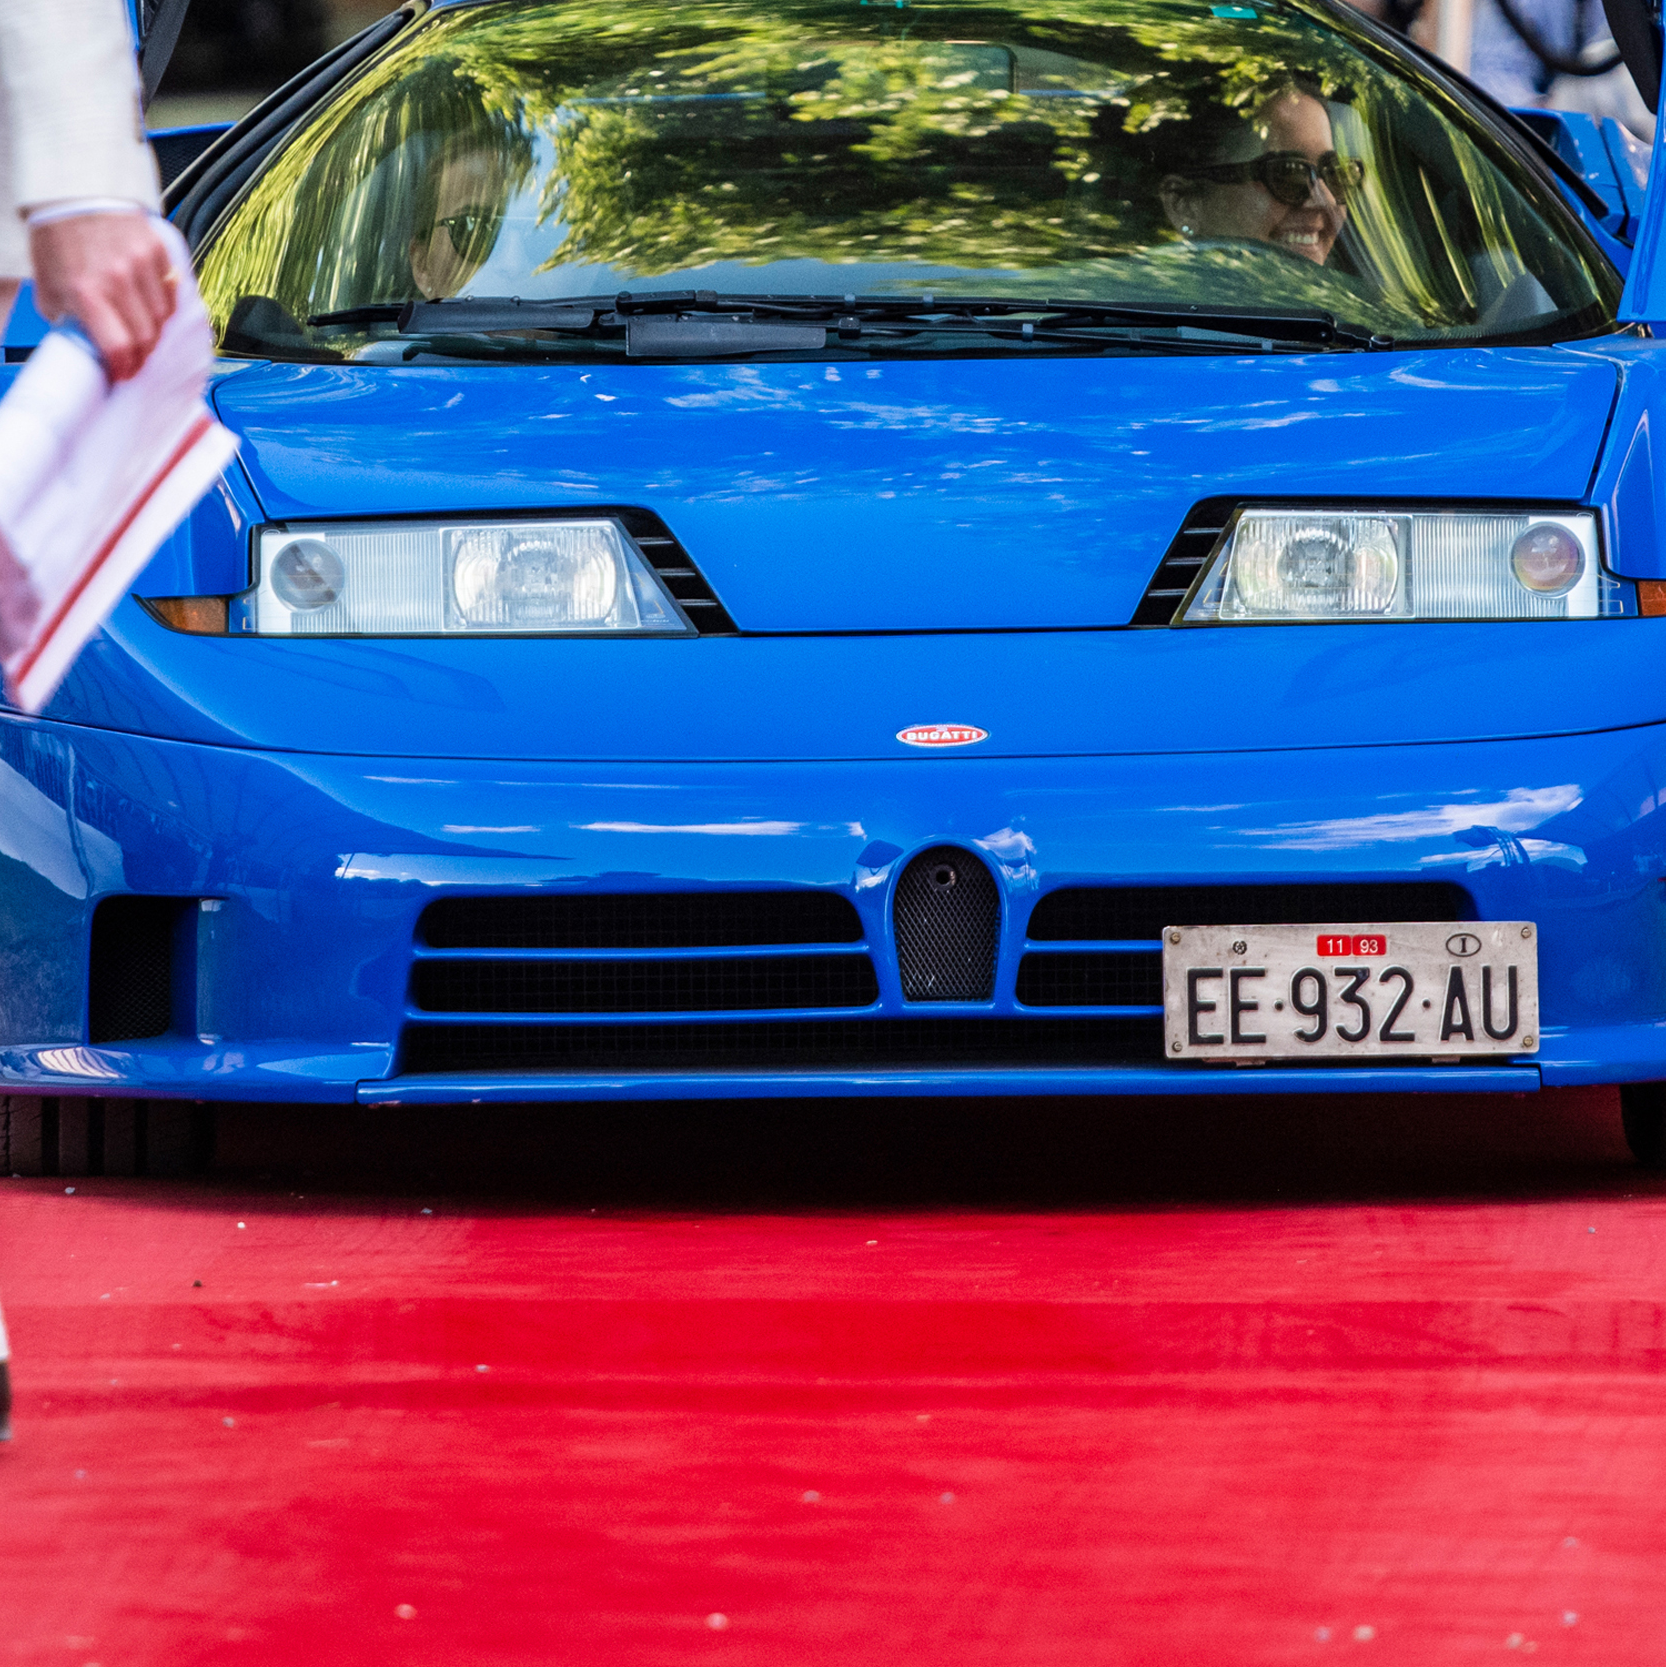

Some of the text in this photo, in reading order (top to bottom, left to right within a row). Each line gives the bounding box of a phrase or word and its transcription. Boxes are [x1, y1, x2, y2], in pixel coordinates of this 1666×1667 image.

[906, 730, 978, 741] BUGATTI
[1326, 938, 1379, 954] 11 93
